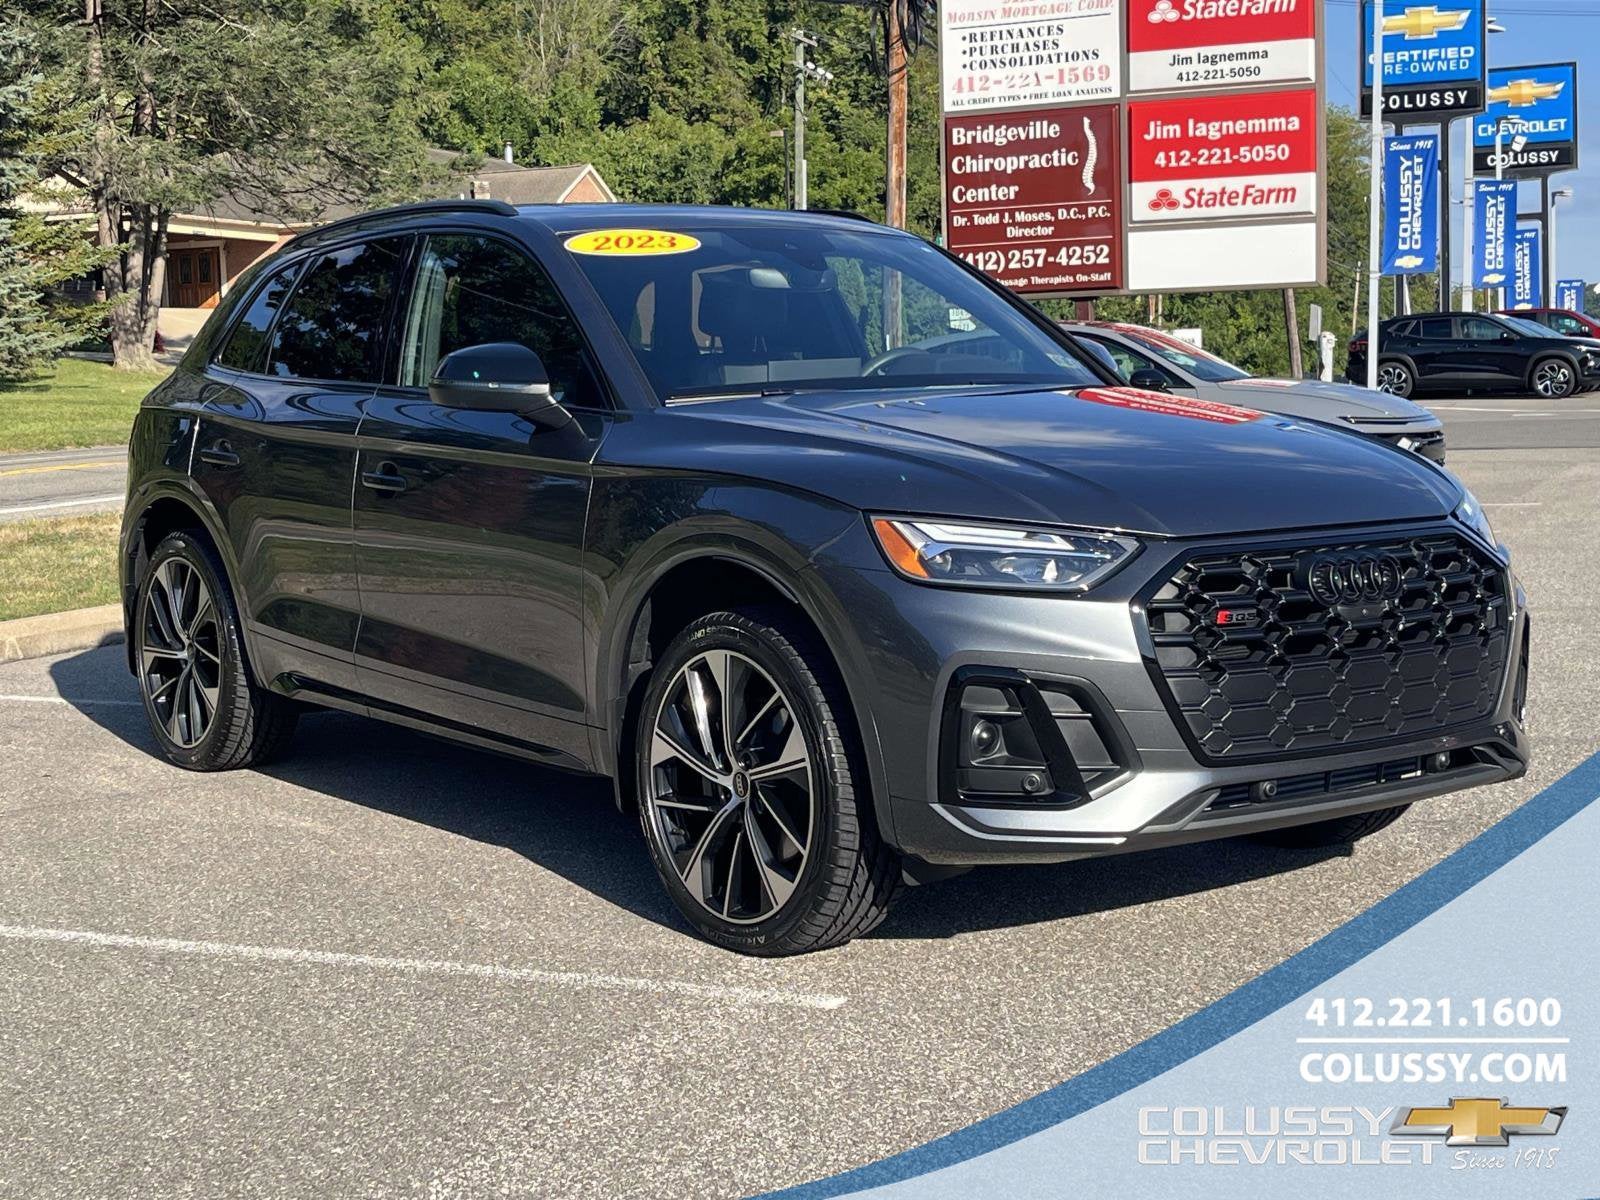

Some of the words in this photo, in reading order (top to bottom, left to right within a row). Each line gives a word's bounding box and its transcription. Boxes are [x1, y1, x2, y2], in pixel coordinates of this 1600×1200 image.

[1000, 2, 1073, 19] MORTGAGE
[968, 24, 1065, 44] REFINANCES
[968, 39, 1060, 57] PURCHASES
[1168, 54, 1193, 67] Jim
[1197, 49, 1269, 66] Iagnemma
[968, 49, 1100, 71] CONSOLIDATIONS
[1384, 58, 1470, 76] RE-OWNED
[1176, 65, 1261, 82] 412-221-5050
[951, 99, 965, 107] ALL
[967, 97, 996, 105] CREDIT
[998, 94, 1022, 103] TYPES
[1029, 92, 1049, 100] FREE
[1051, 90, 1072, 98] LOAN
[1075, 86, 1113, 96] ANALYSIS
[951, 120, 1061, 147] Bridgeville
[1143, 120, 1181, 141] Jim
[1187, 115, 1300, 141] Iagnemma
[1477, 118, 1567, 137] CHEVROLET
[1154, 143, 1290, 168] 412-221-5050
[1389, 141, 1411, 152] Since
[1414, 139, 1434, 150] 1918
[951, 147, 1079, 174] Chiropractic
[1486, 150, 1559, 168] COLUSSY
[951, 183, 1019, 204] Center
[1397, 156, 1413, 250] COLUSSY
[1411, 154, 1424, 250] CHEVROLET
[953, 215, 971, 227] Dr.
[972, 212, 1000, 226] Todd
[1002, 212, 1013, 224] J.
[1014, 210, 1055, 223] Moses,
[1057, 208, 1086, 220] D.C.,
[1087, 206, 1111, 218] P.C.
[593, 234, 678, 251] 2023
[1006, 226, 1055, 238] Director
[1484, 195, 1497, 270] COLUSSY
[1495, 194, 1505, 270] CHEVROLET
[1008, 244, 1110, 269] 257-4252
[997, 277, 1028, 287] assage
[1030, 274, 1074, 286] Therapists
[1075, 272, 1112, 283] On-Staff
[1515, 242, 1524, 300] COLUSSY
